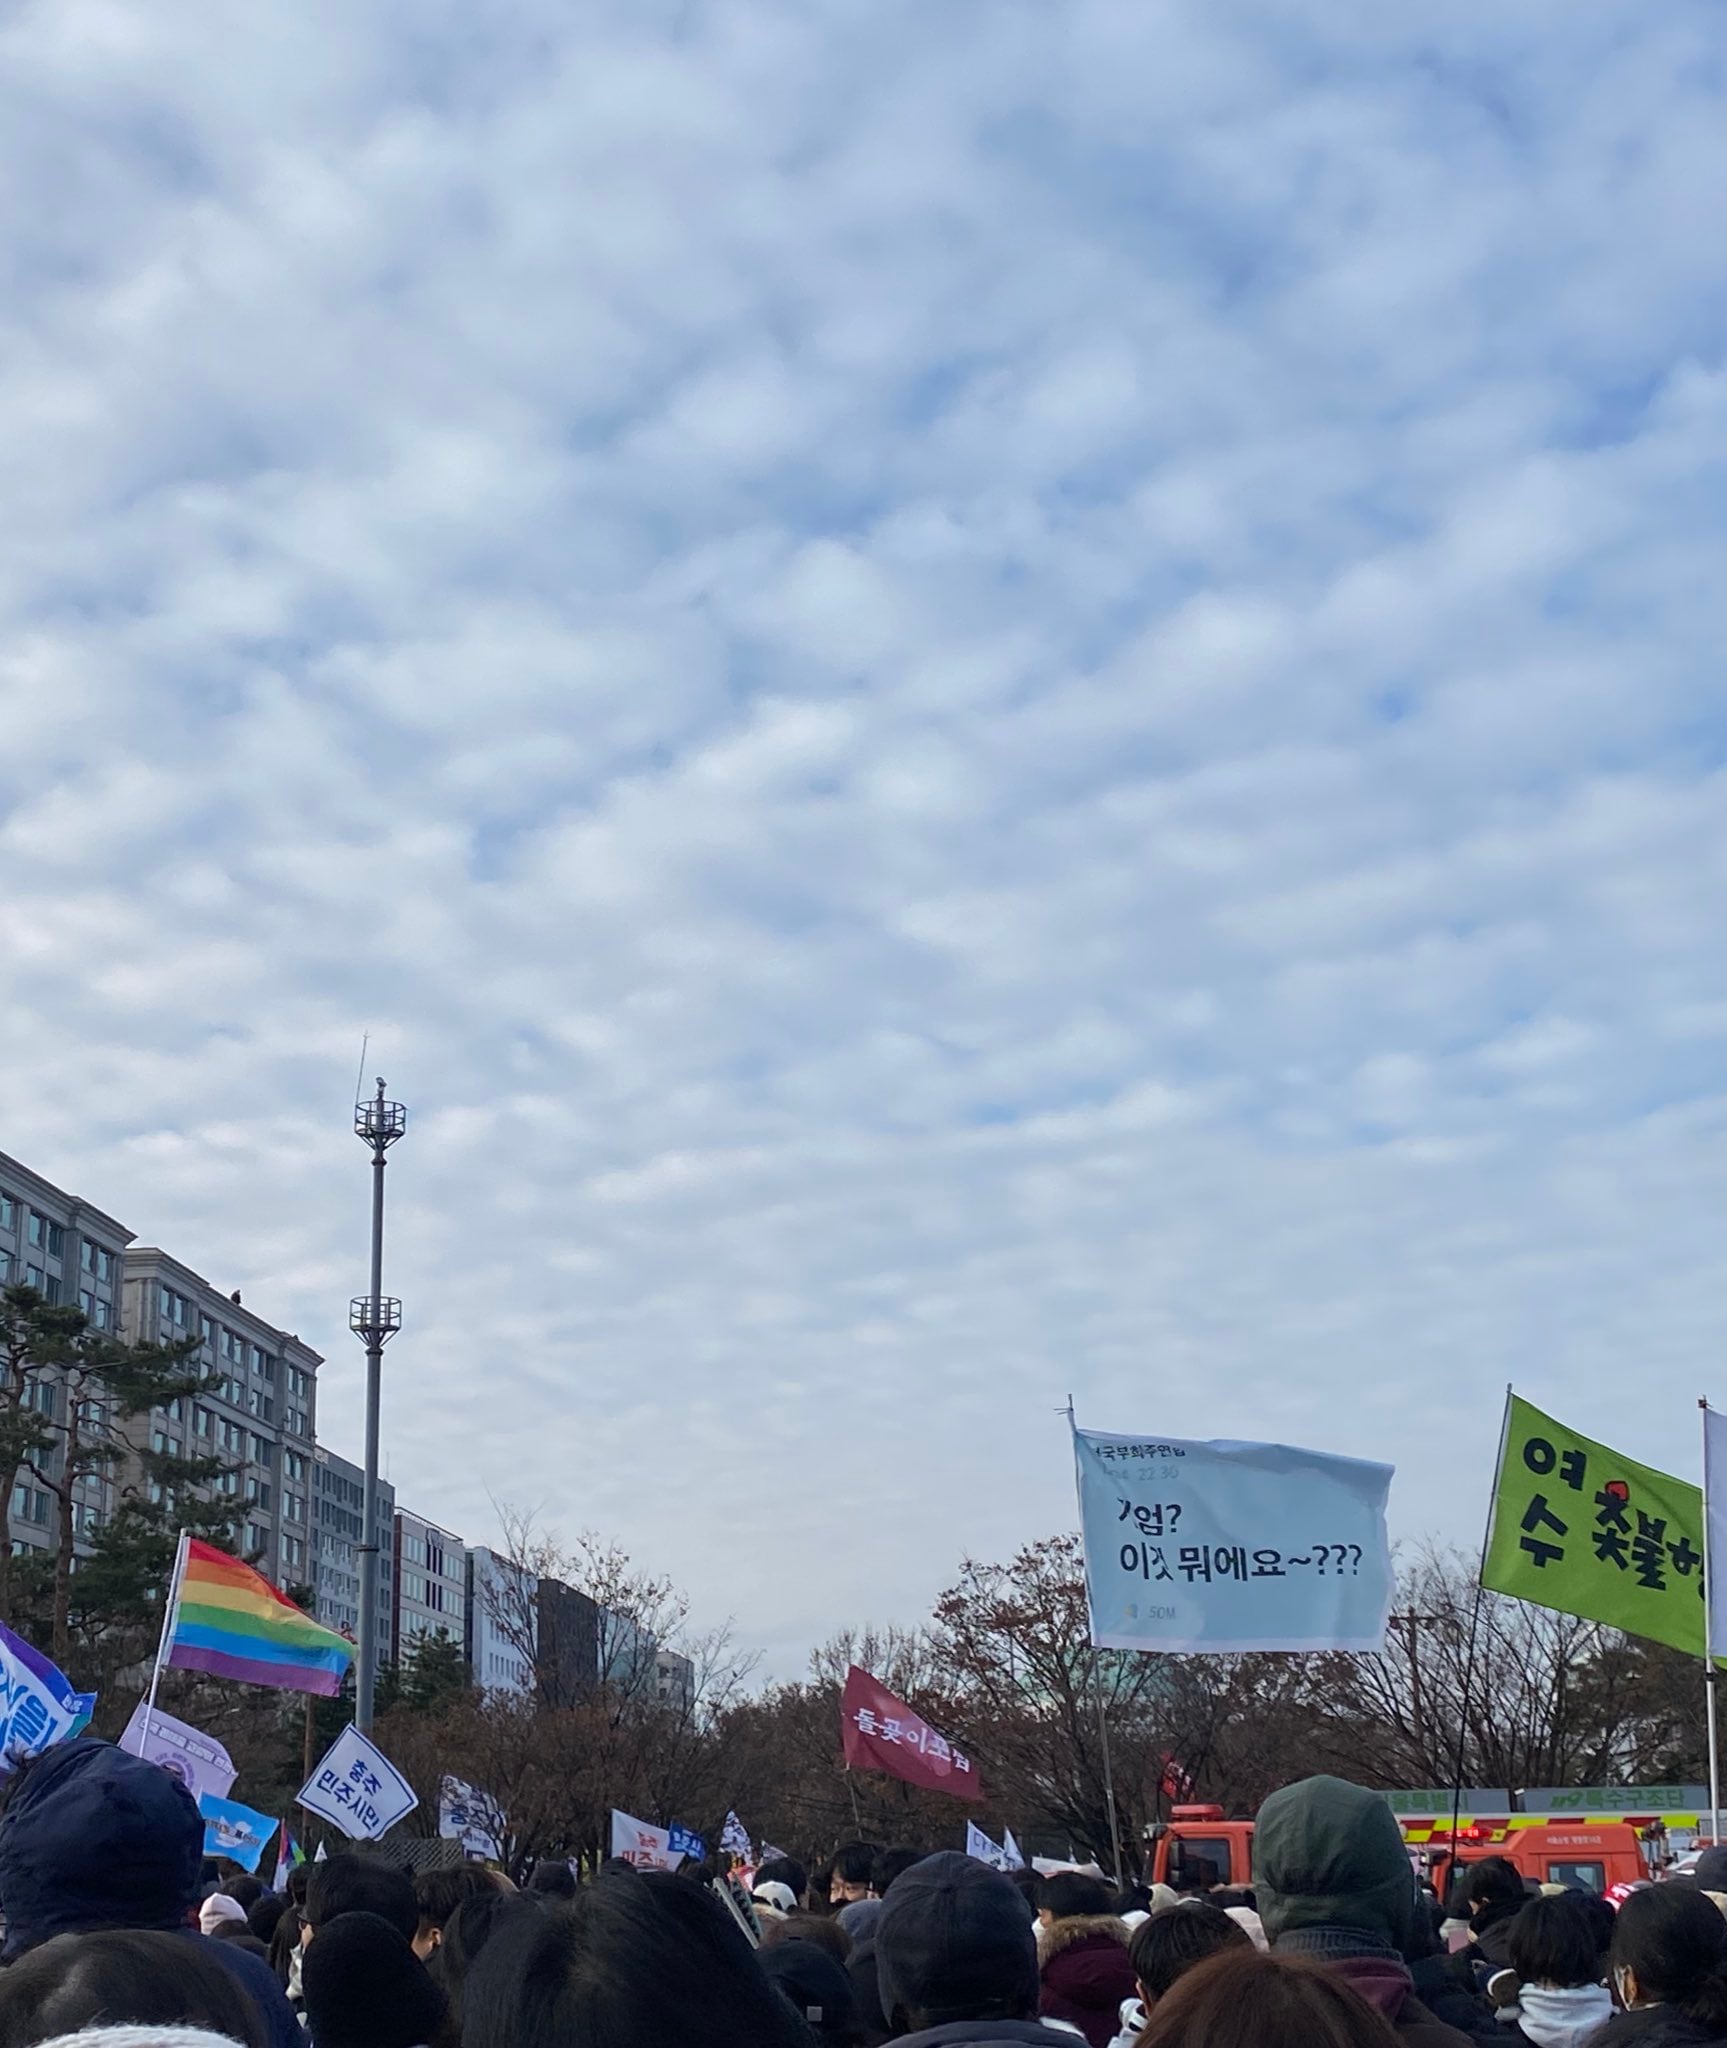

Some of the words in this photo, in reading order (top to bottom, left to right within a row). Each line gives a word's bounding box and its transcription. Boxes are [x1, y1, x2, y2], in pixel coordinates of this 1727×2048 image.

[1177, 1544, 1363, 1583] 뭐에요~???
[348, 1758, 383, 1797] 충주
[316, 1769, 380, 1831] 민주시민
